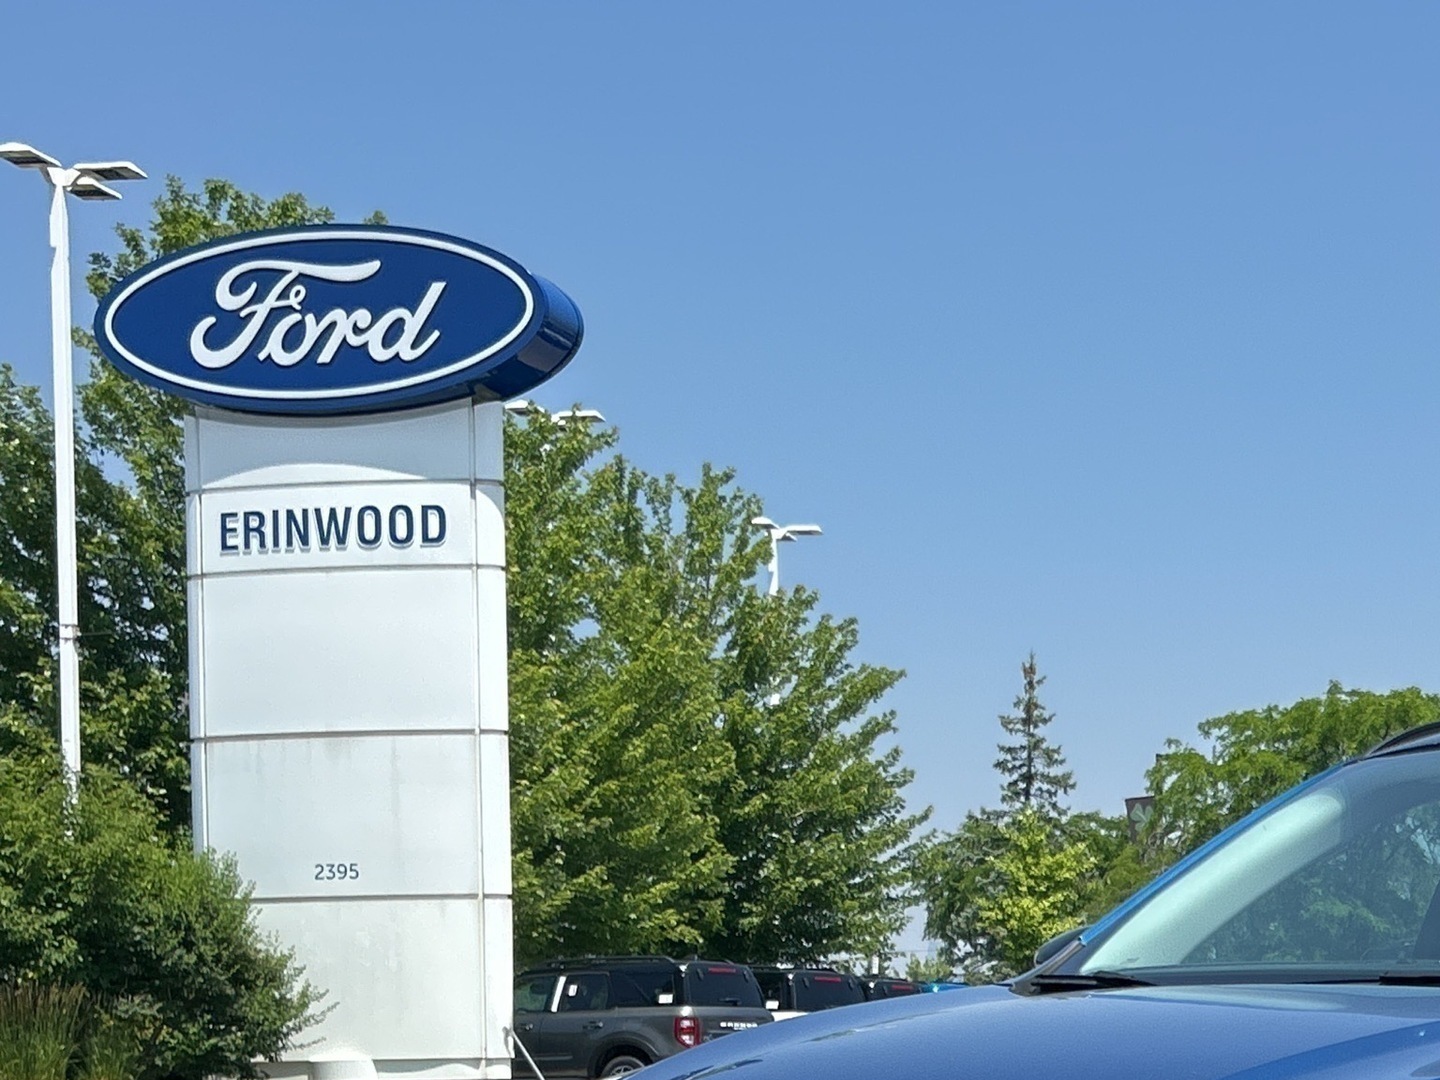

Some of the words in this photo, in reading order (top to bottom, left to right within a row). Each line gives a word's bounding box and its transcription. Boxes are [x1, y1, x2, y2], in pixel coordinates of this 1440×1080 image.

[190, 260, 447, 369] Ford
[220, 504, 448, 556] ERINWOOD
[314, 863, 360, 880] 2395
